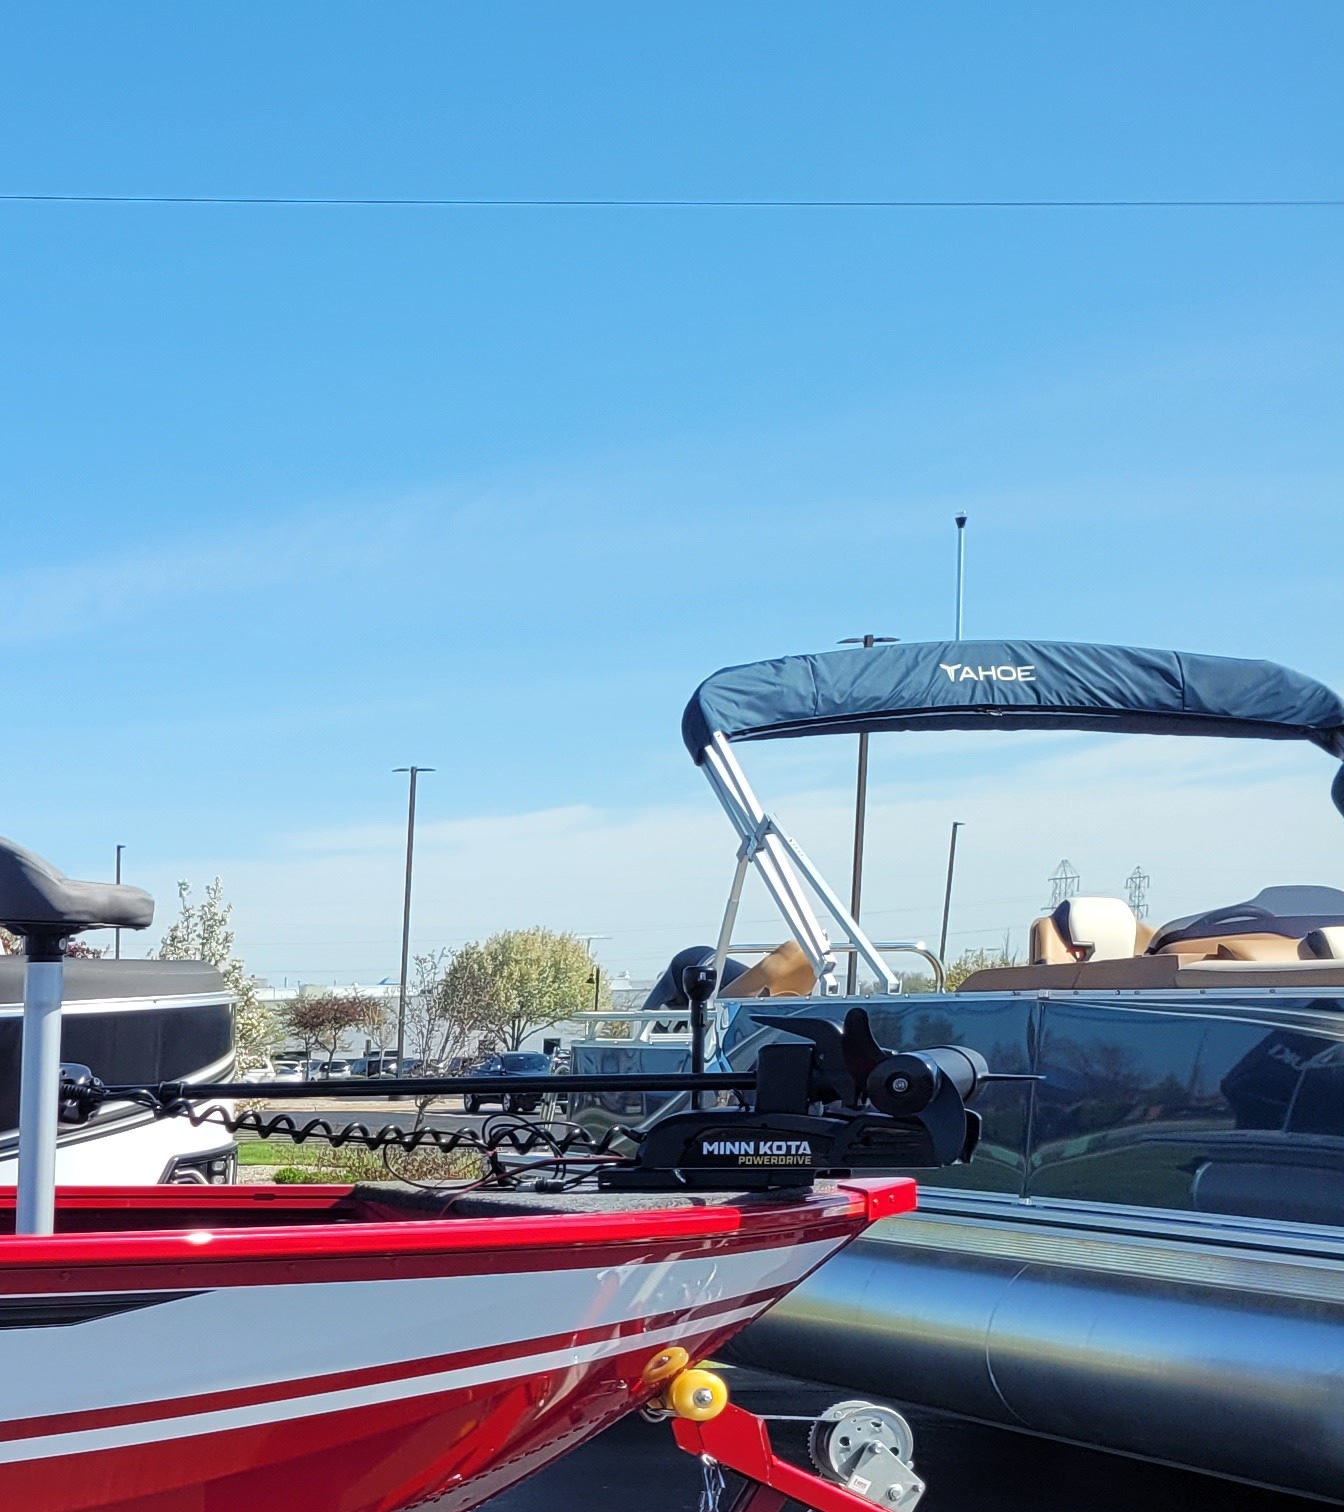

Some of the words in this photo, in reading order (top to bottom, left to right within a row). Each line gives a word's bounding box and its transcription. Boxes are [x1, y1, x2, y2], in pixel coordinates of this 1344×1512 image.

[939, 663, 1036, 684] TAHOE
[702, 1141, 754, 1155] MINN
[759, 1141, 812, 1155] KOTA
[737, 1156, 812, 1165] POWERDRIVE
